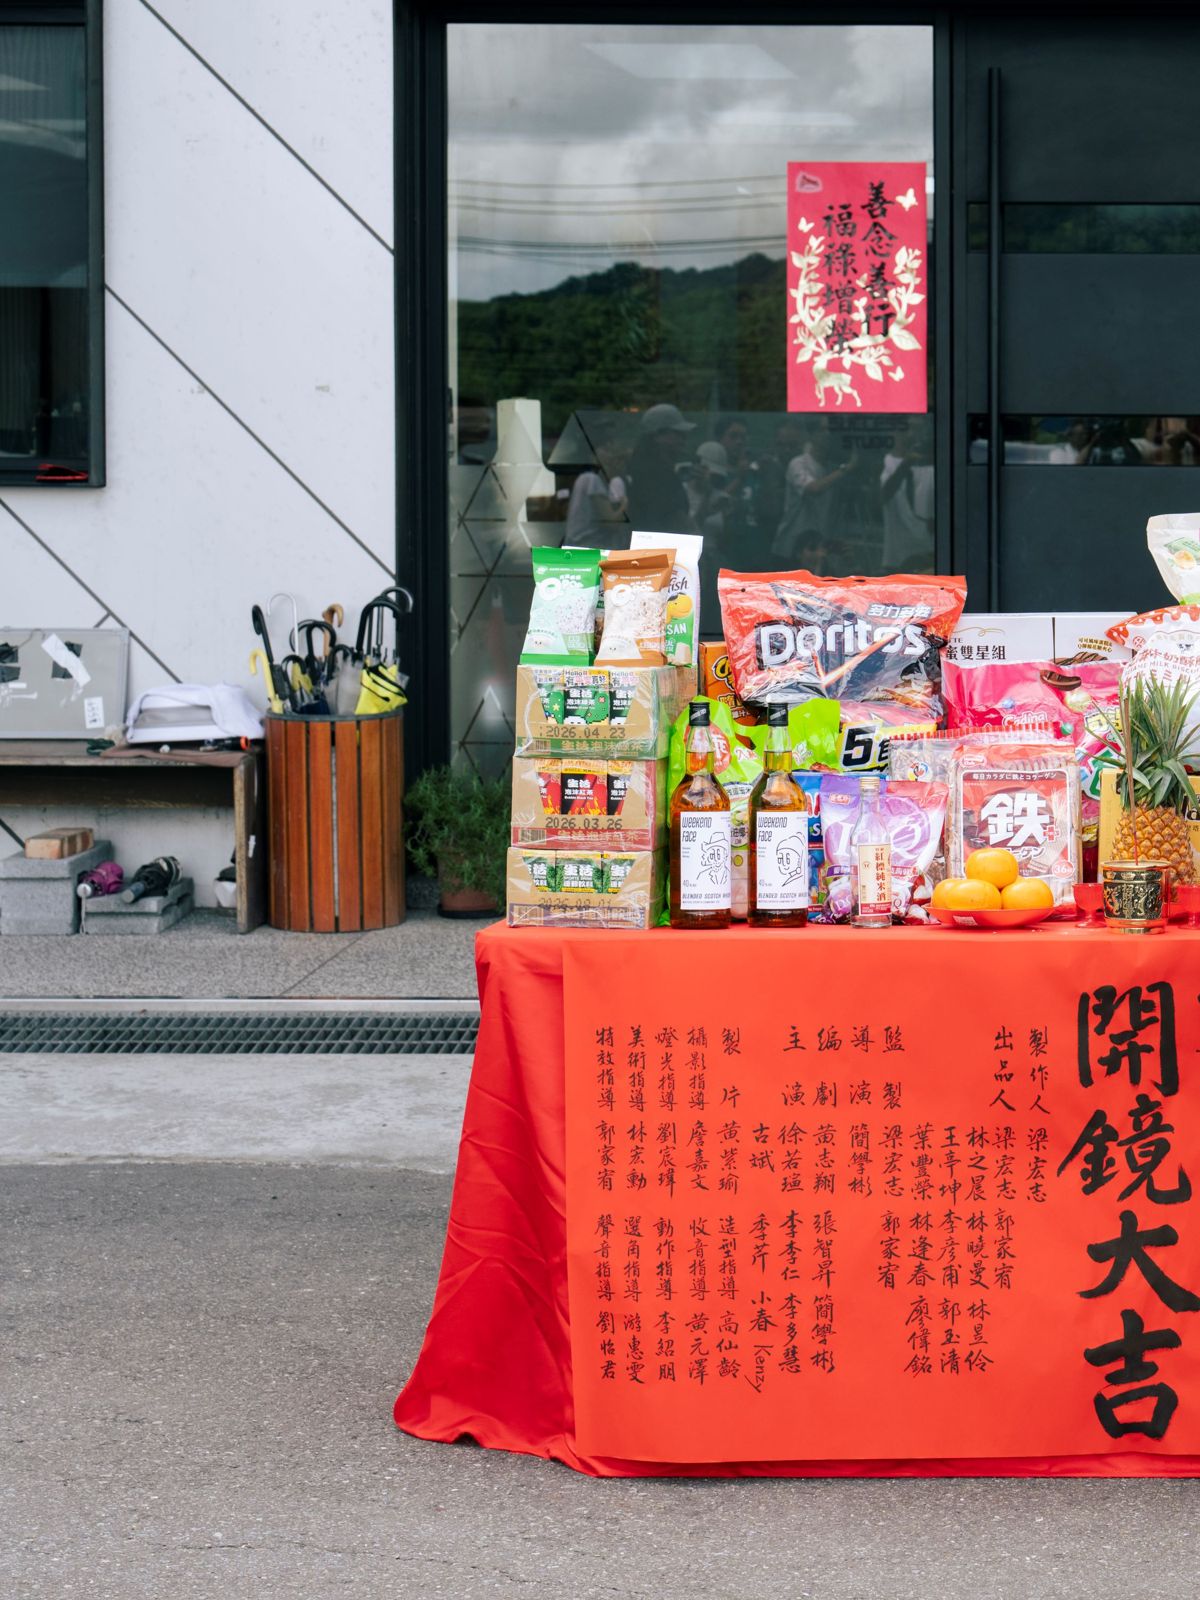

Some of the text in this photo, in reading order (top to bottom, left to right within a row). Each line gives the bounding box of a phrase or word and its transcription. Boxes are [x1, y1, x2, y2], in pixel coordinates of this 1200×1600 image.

[861, 180, 897, 338] 善念善行
[668, 577, 688, 593] fish
[867, 603, 932, 619] 多力多滋
[760, 618, 926, 667] Doritos
[545, 817, 623, 830] 2026.03.26
[980, 793, 1050, 847] 鉄
[875, 852, 886, 901] 紅標純米酒
[1008, 847, 1045, 858] ーゲン
[746, 1344, 774, 1394] Kenzy
